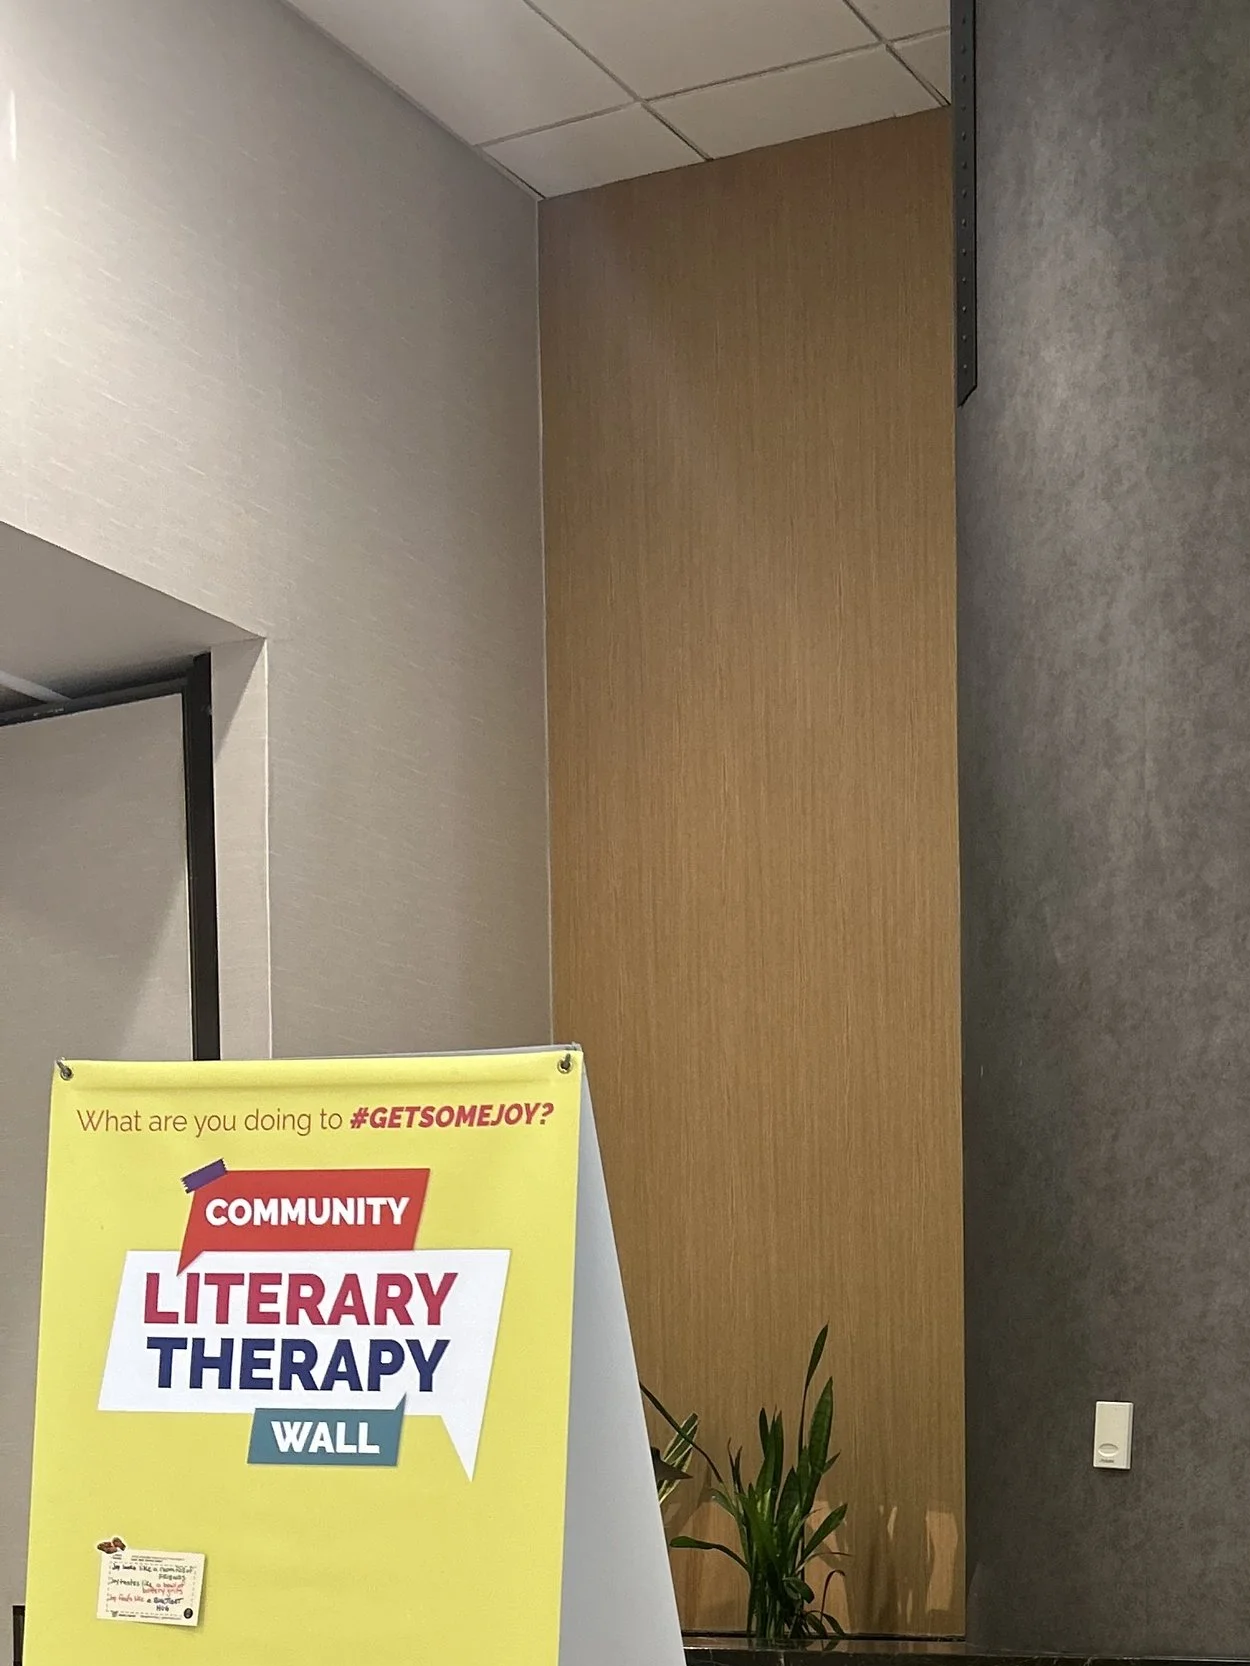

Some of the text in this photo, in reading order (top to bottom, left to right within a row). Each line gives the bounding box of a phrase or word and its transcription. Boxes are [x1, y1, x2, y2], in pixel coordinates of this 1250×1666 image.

[77, 1103, 554, 1138] What are you doing to #GETSOMEJOY?
[205, 1197, 411, 1227] COMMUNITY
[142, 1271, 458, 1325] LITERARY
[146, 1336, 450, 1392] THERAPY
[271, 1420, 380, 1454] WALL
